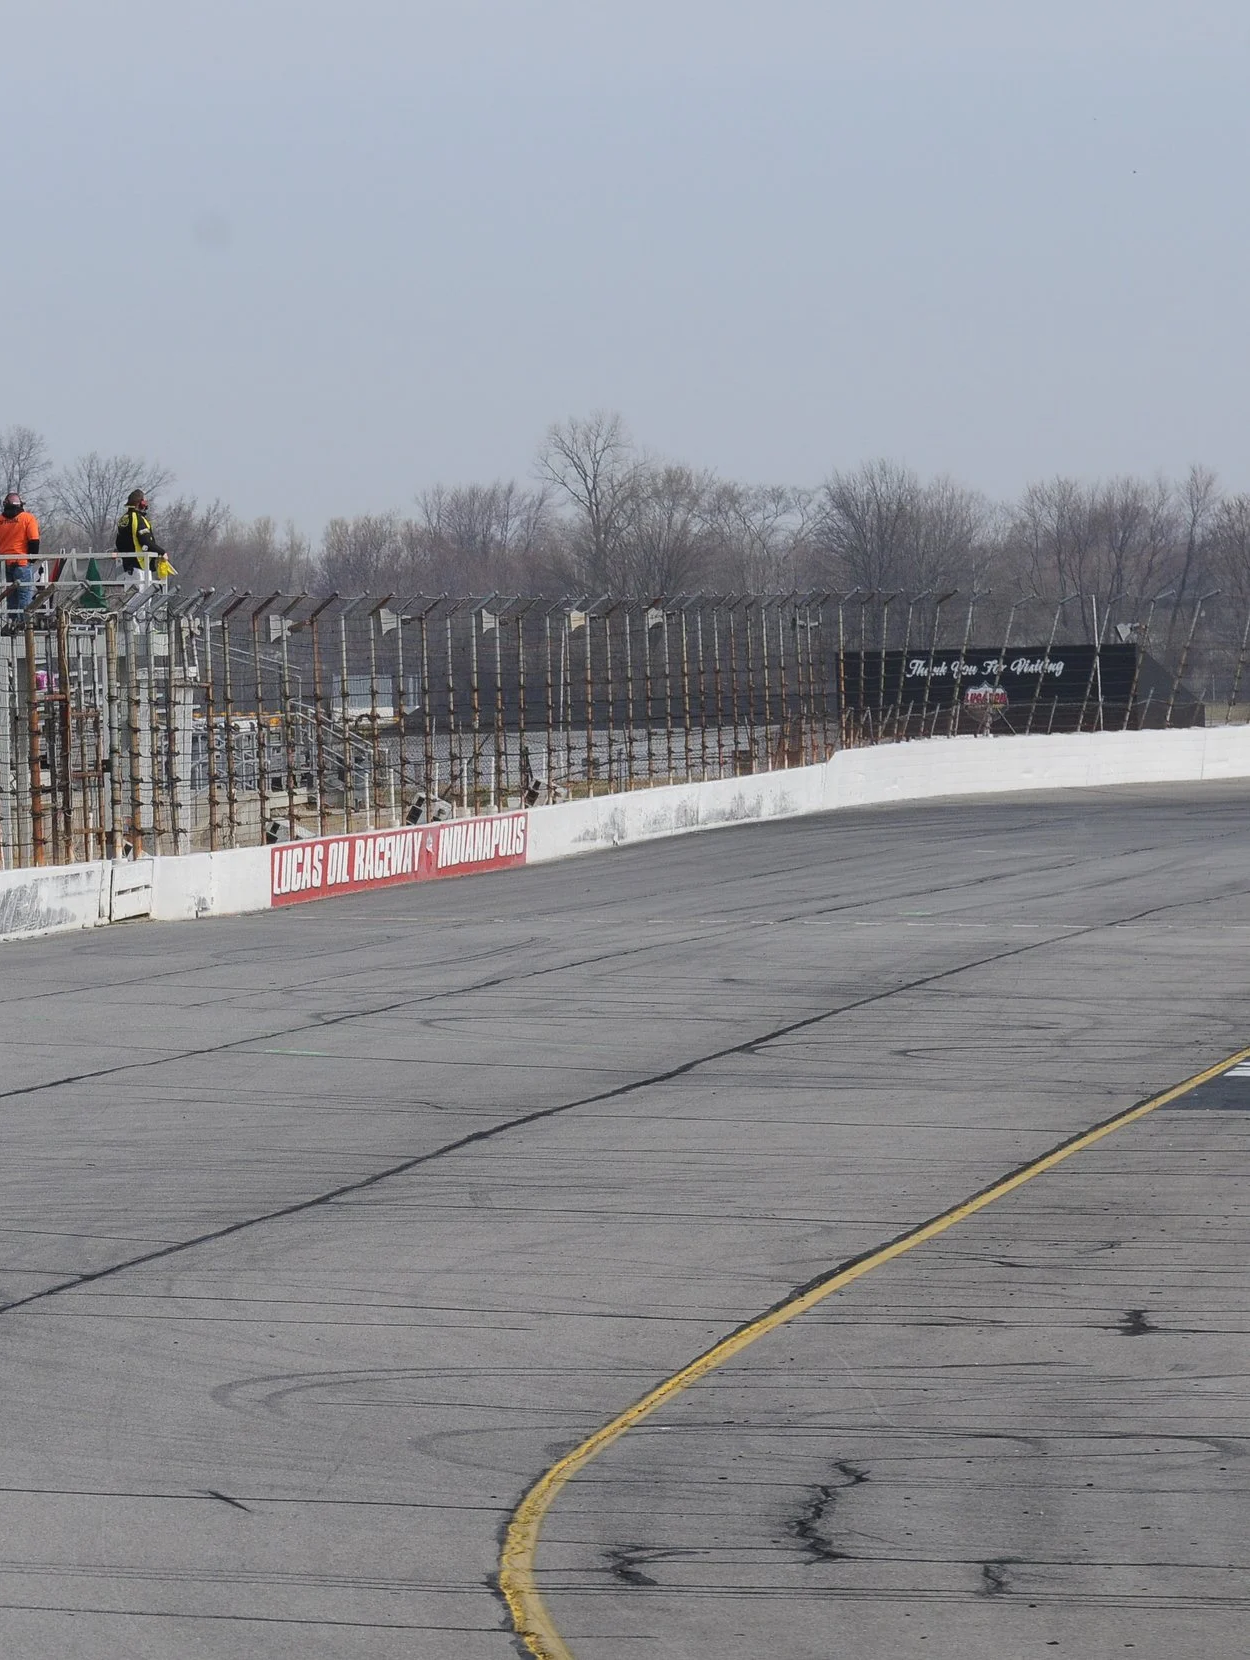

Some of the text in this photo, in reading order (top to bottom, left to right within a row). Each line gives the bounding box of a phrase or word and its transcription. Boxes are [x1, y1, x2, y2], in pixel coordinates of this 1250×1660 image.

[273, 815, 526, 896] LUCAS OIL RACEWAY INDIANAPOLIS
